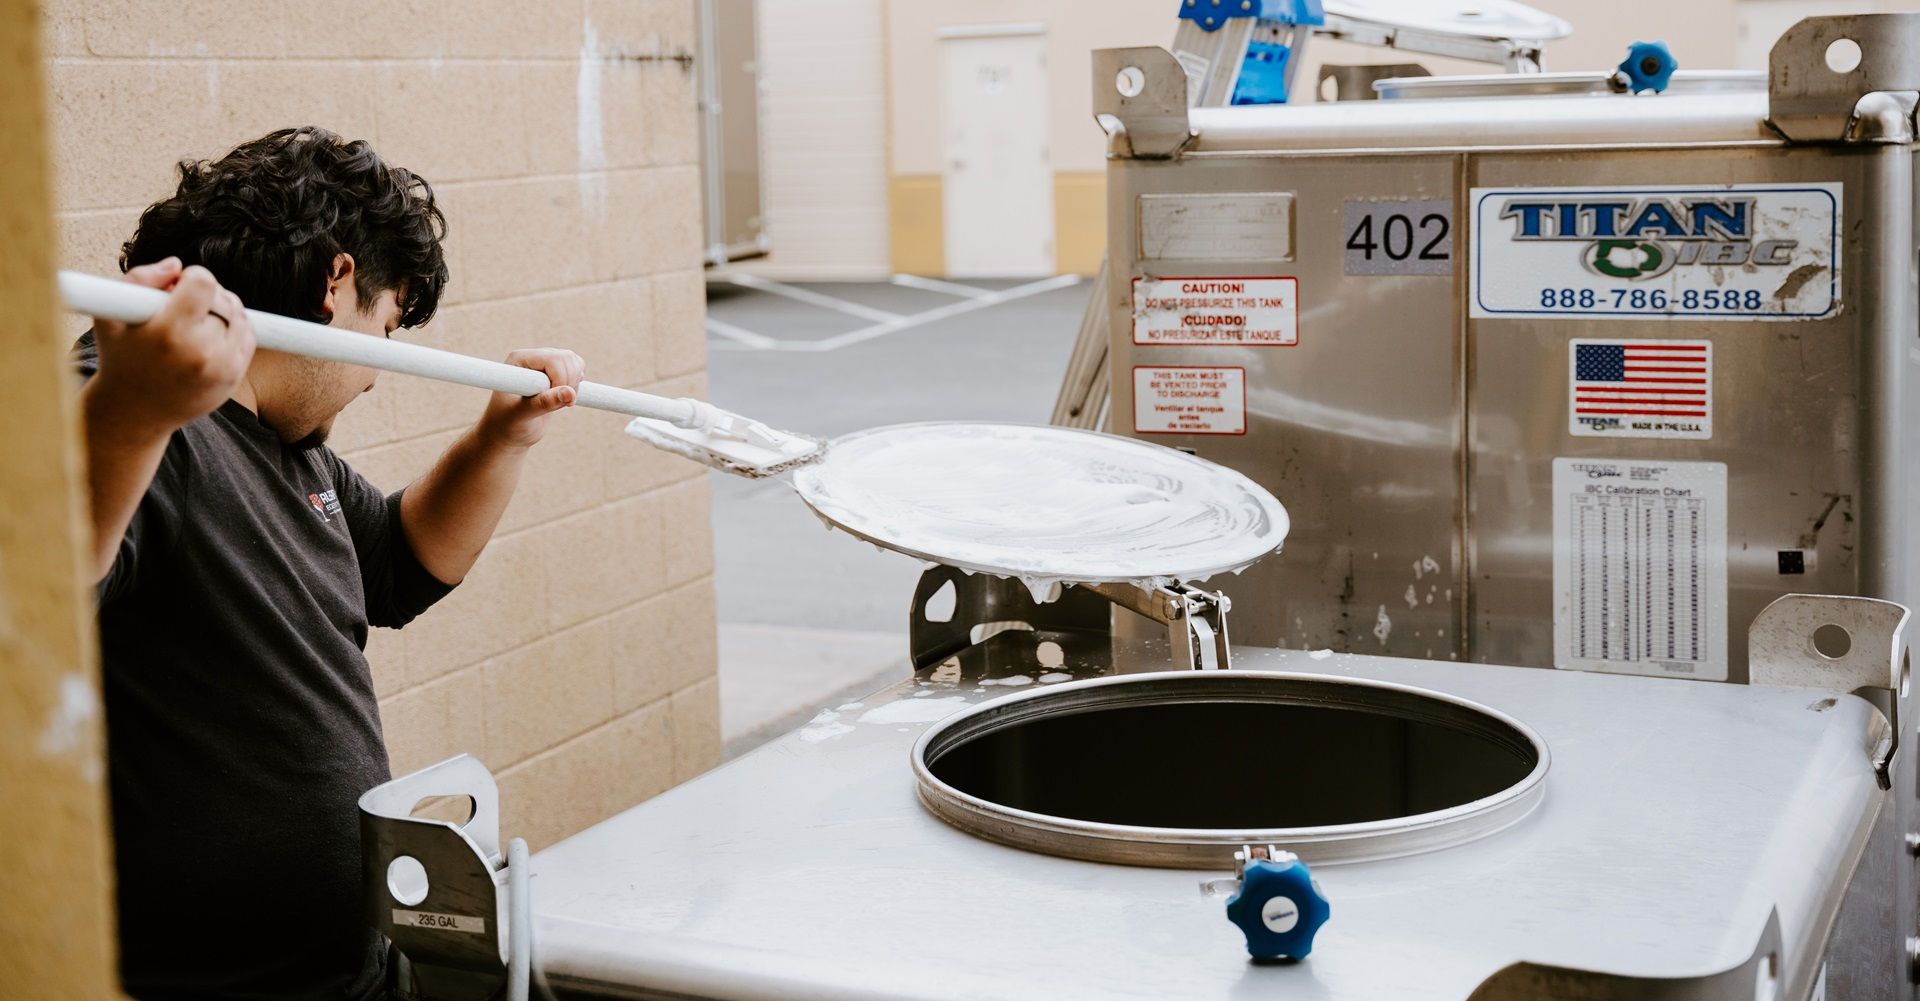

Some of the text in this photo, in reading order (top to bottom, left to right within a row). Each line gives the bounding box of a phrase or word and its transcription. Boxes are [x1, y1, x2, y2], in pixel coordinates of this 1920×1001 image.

[1500, 197, 1757, 241] TITAN
[1346, 213, 1450, 260] 402
[1676, 240, 1798, 265] IBC
[1182, 283, 1245, 294] CAUTION!
[1146, 298, 1158, 308] DO
[1237, 298, 1256, 308] THIS
[1259, 298, 1283, 308] TANK
[1541, 288, 1762, 310] 888-786-8588
[1148, 330, 1281, 340] NO PRESURIZAR ESTE TANQUE
[1200, 372, 1223, 380] MUST
[1578, 417, 1619, 426] TITAN
[1631, 422, 1652, 430] MADE
[1664, 423, 1679, 431] THE
[1585, 485, 1691, 496] IBC Calibration Chart
[418, 914, 458, 928] 235 GAL
